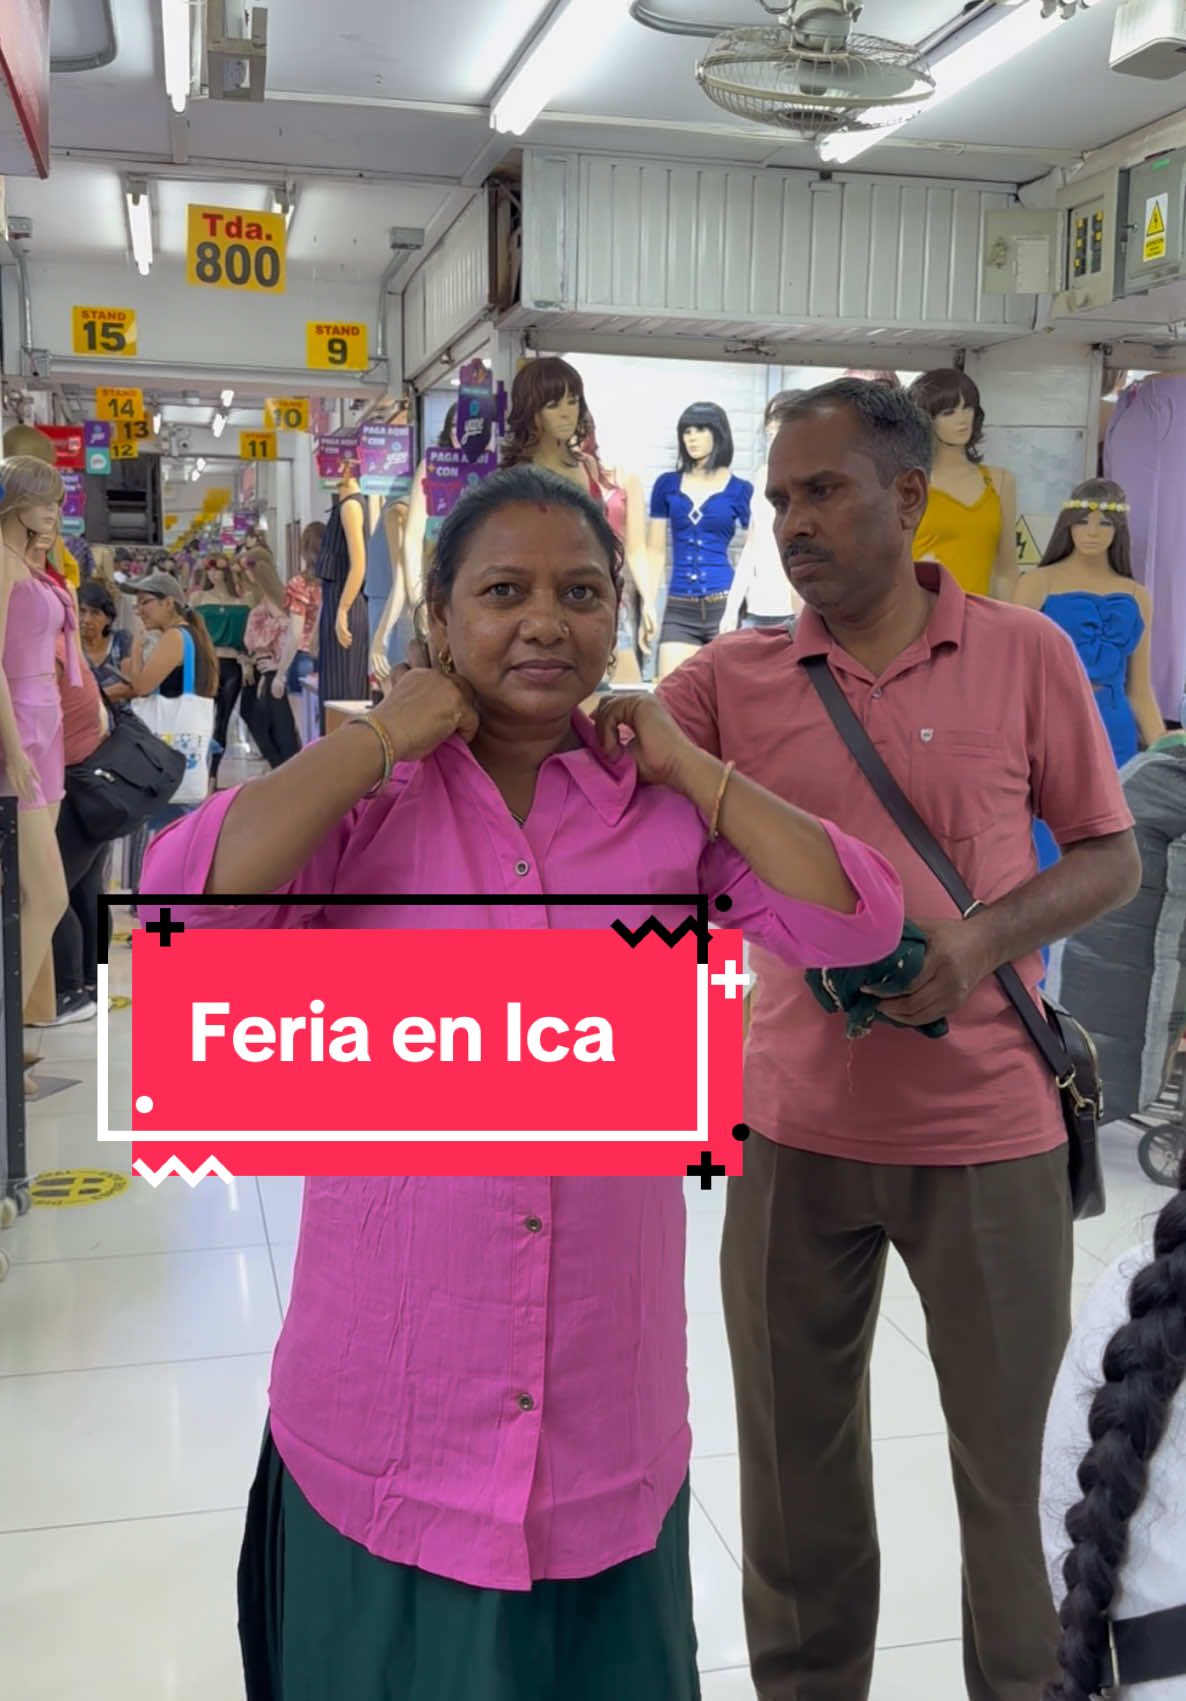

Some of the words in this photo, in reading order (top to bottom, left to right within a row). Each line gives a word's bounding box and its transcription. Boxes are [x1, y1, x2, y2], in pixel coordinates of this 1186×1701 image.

[202, 212, 272, 241] Tda.
[195, 242, 280, 287] 800
[81, 310, 126, 321] STAND
[83, 321, 126, 352] 15
[315, 325, 360, 336] STAND
[327, 338, 348, 365] 9
[108, 398, 134, 418] 14
[274, 408, 302, 428] 10
[123, 420, 149, 440] 13
[112, 444, 134, 456] 12
[248, 439, 267, 457] 11
[430, 451, 460, 464] PAGA
[435, 466, 459, 477] CON
